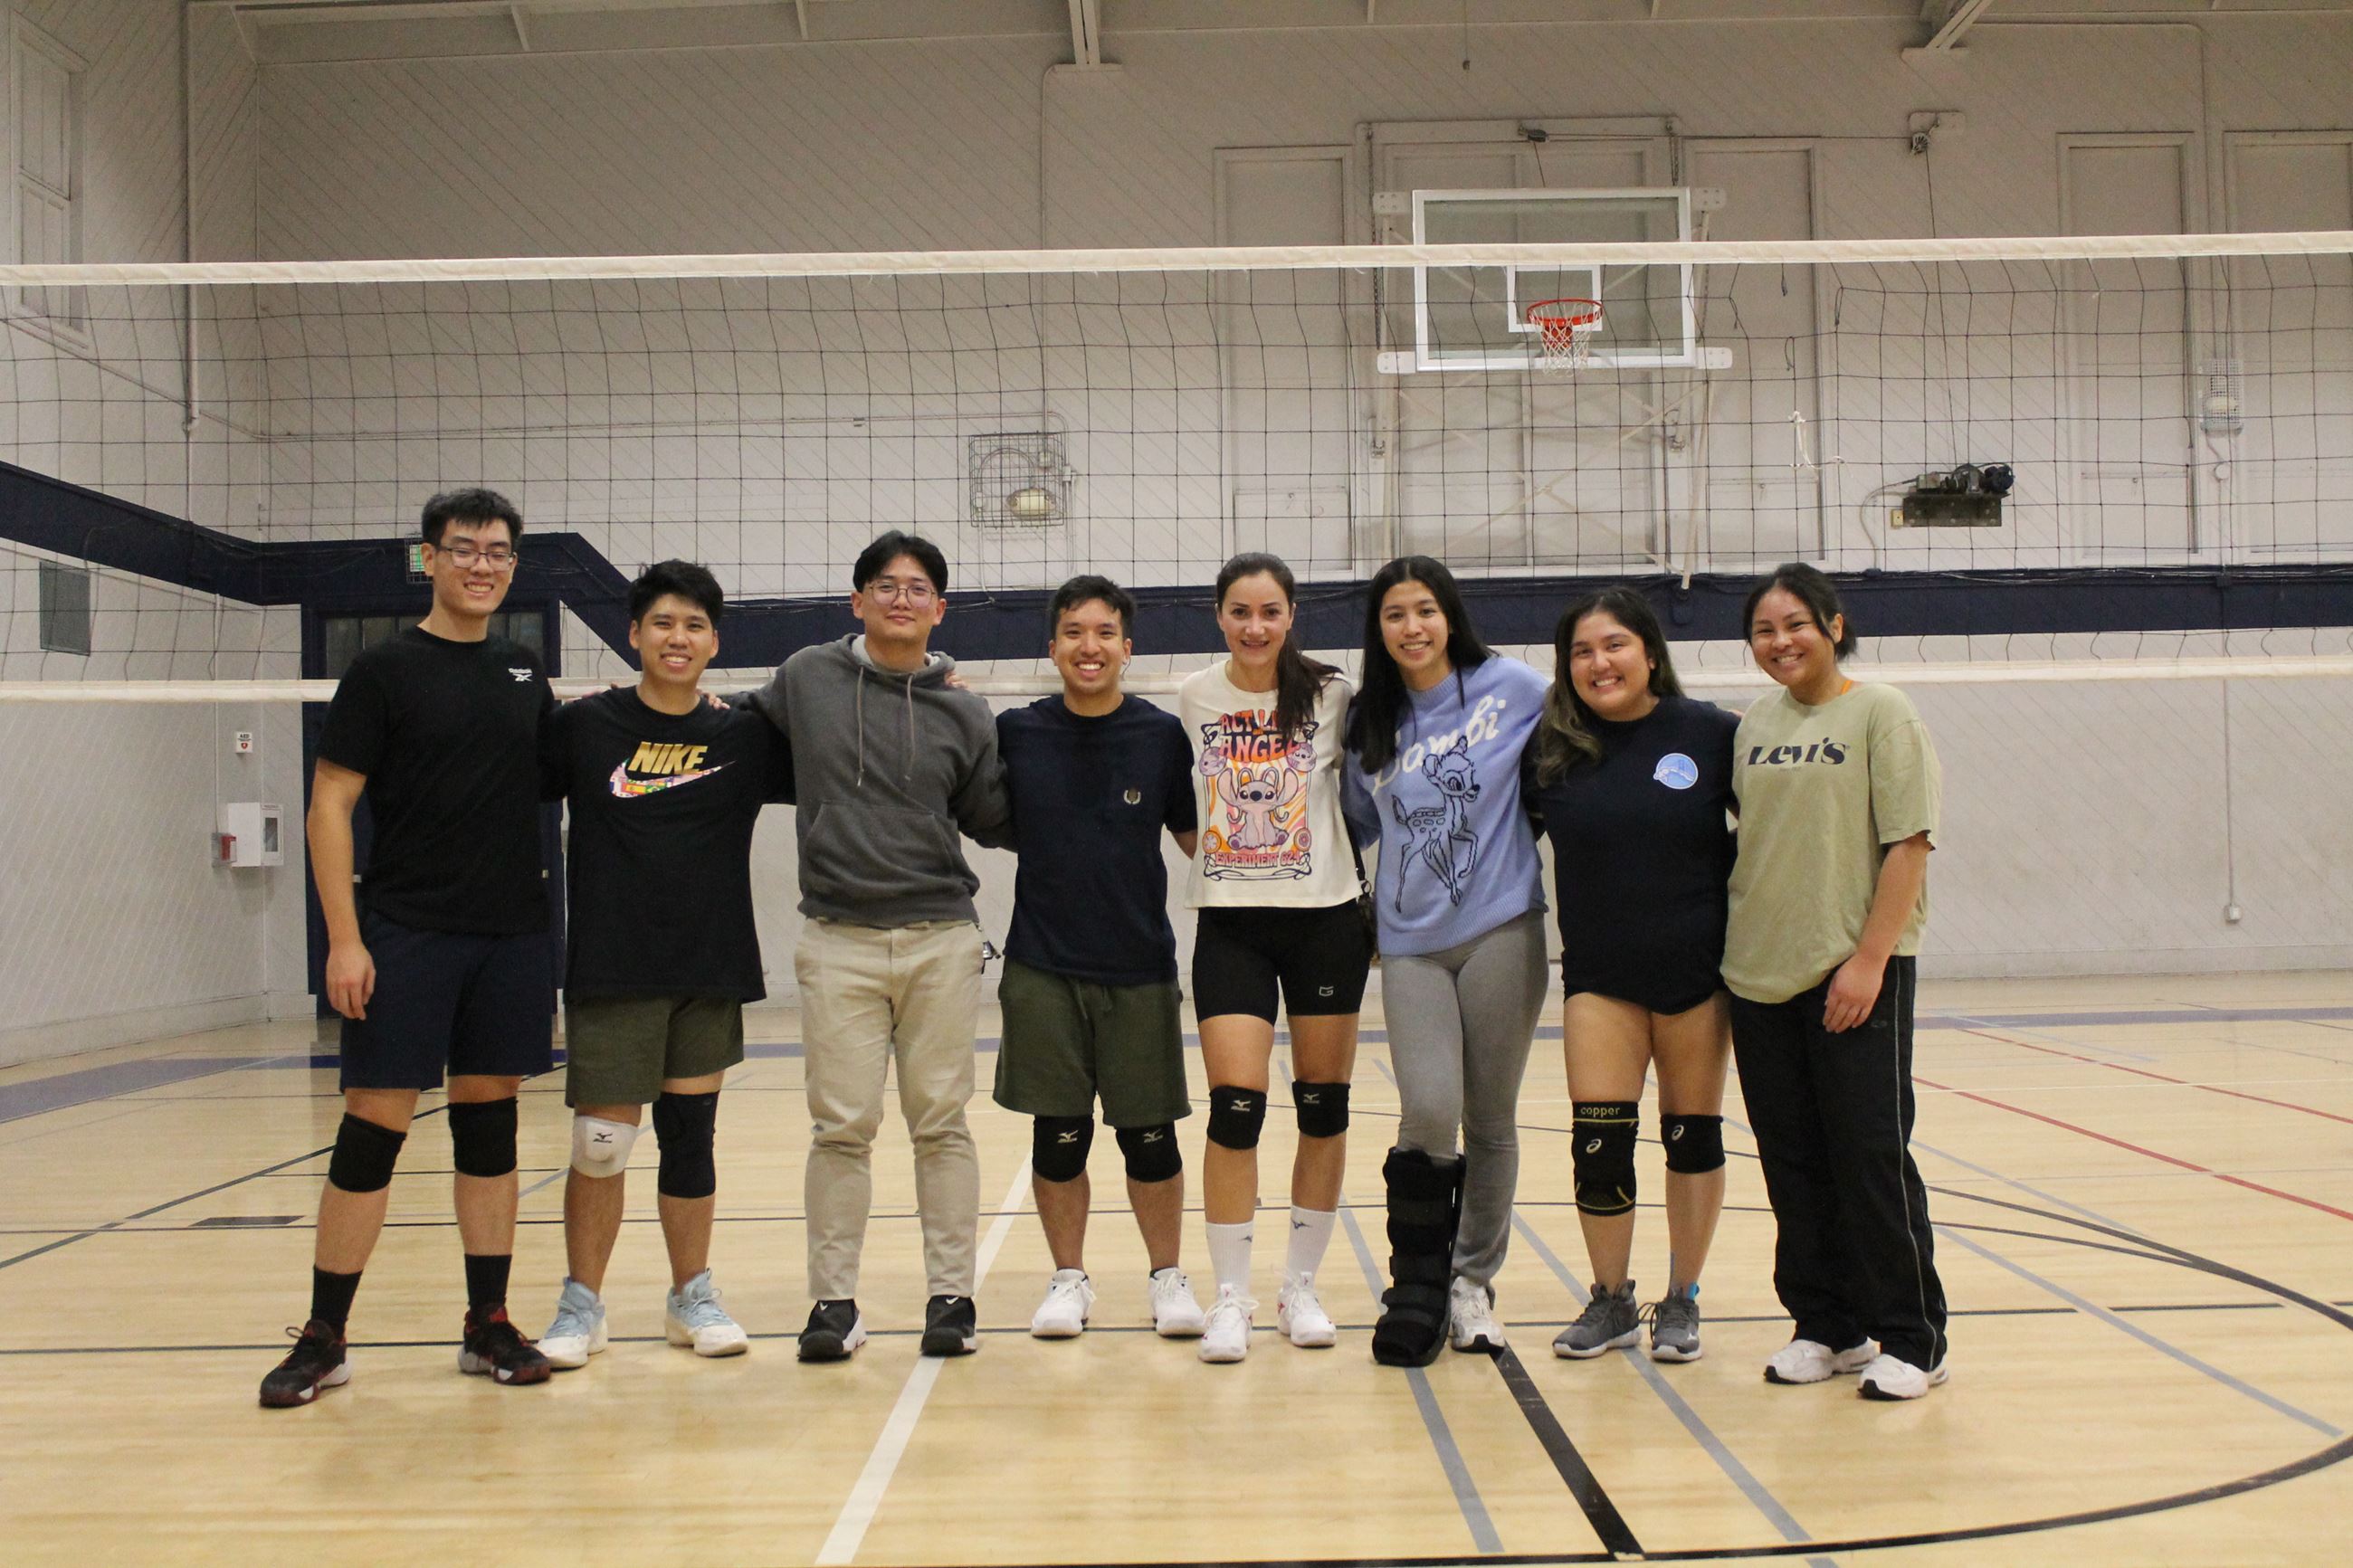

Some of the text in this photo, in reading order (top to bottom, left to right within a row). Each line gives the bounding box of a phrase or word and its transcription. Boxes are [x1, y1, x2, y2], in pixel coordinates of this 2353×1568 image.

[1219, 708, 1279, 734] ACT LI
[627, 741, 708, 775] NIKE
[1215, 851, 1300, 869] EXPERIMENT 624
[1580, 1107, 1621, 1118] copper
